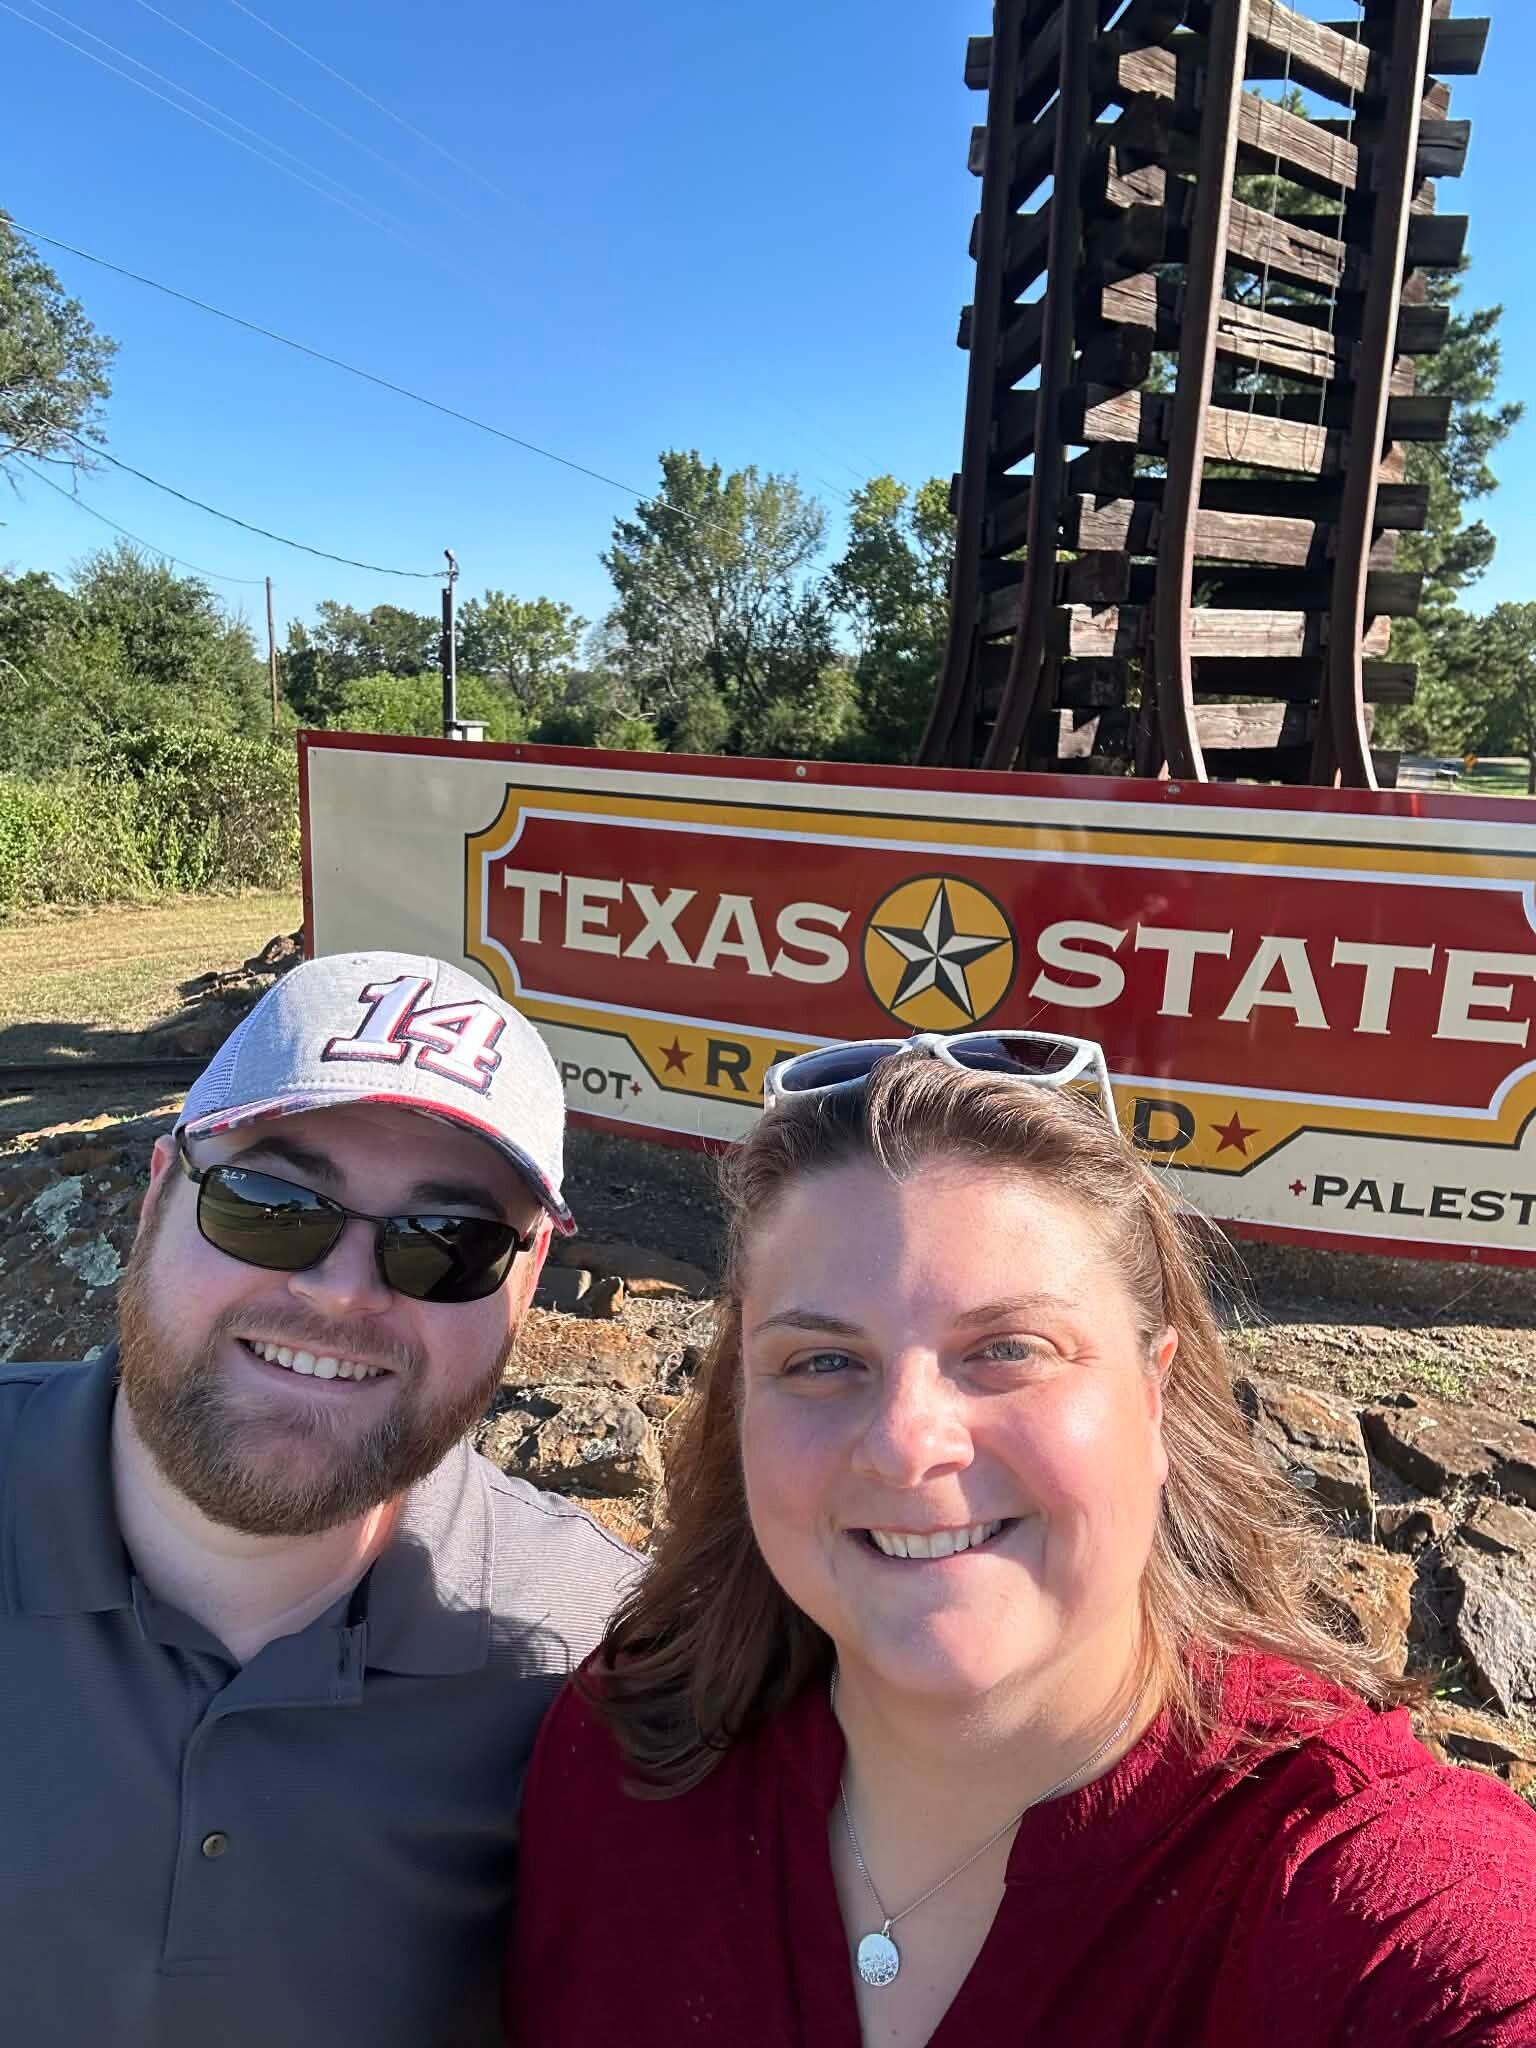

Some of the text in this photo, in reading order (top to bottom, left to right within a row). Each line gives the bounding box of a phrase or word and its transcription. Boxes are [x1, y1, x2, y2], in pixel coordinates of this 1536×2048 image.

[503, 864, 1536, 1049] TEXAS STATE
[321, 975, 507, 1095] 14
[555, 1060, 632, 1100] POT
[1311, 1174, 1536, 1226] PALEST
